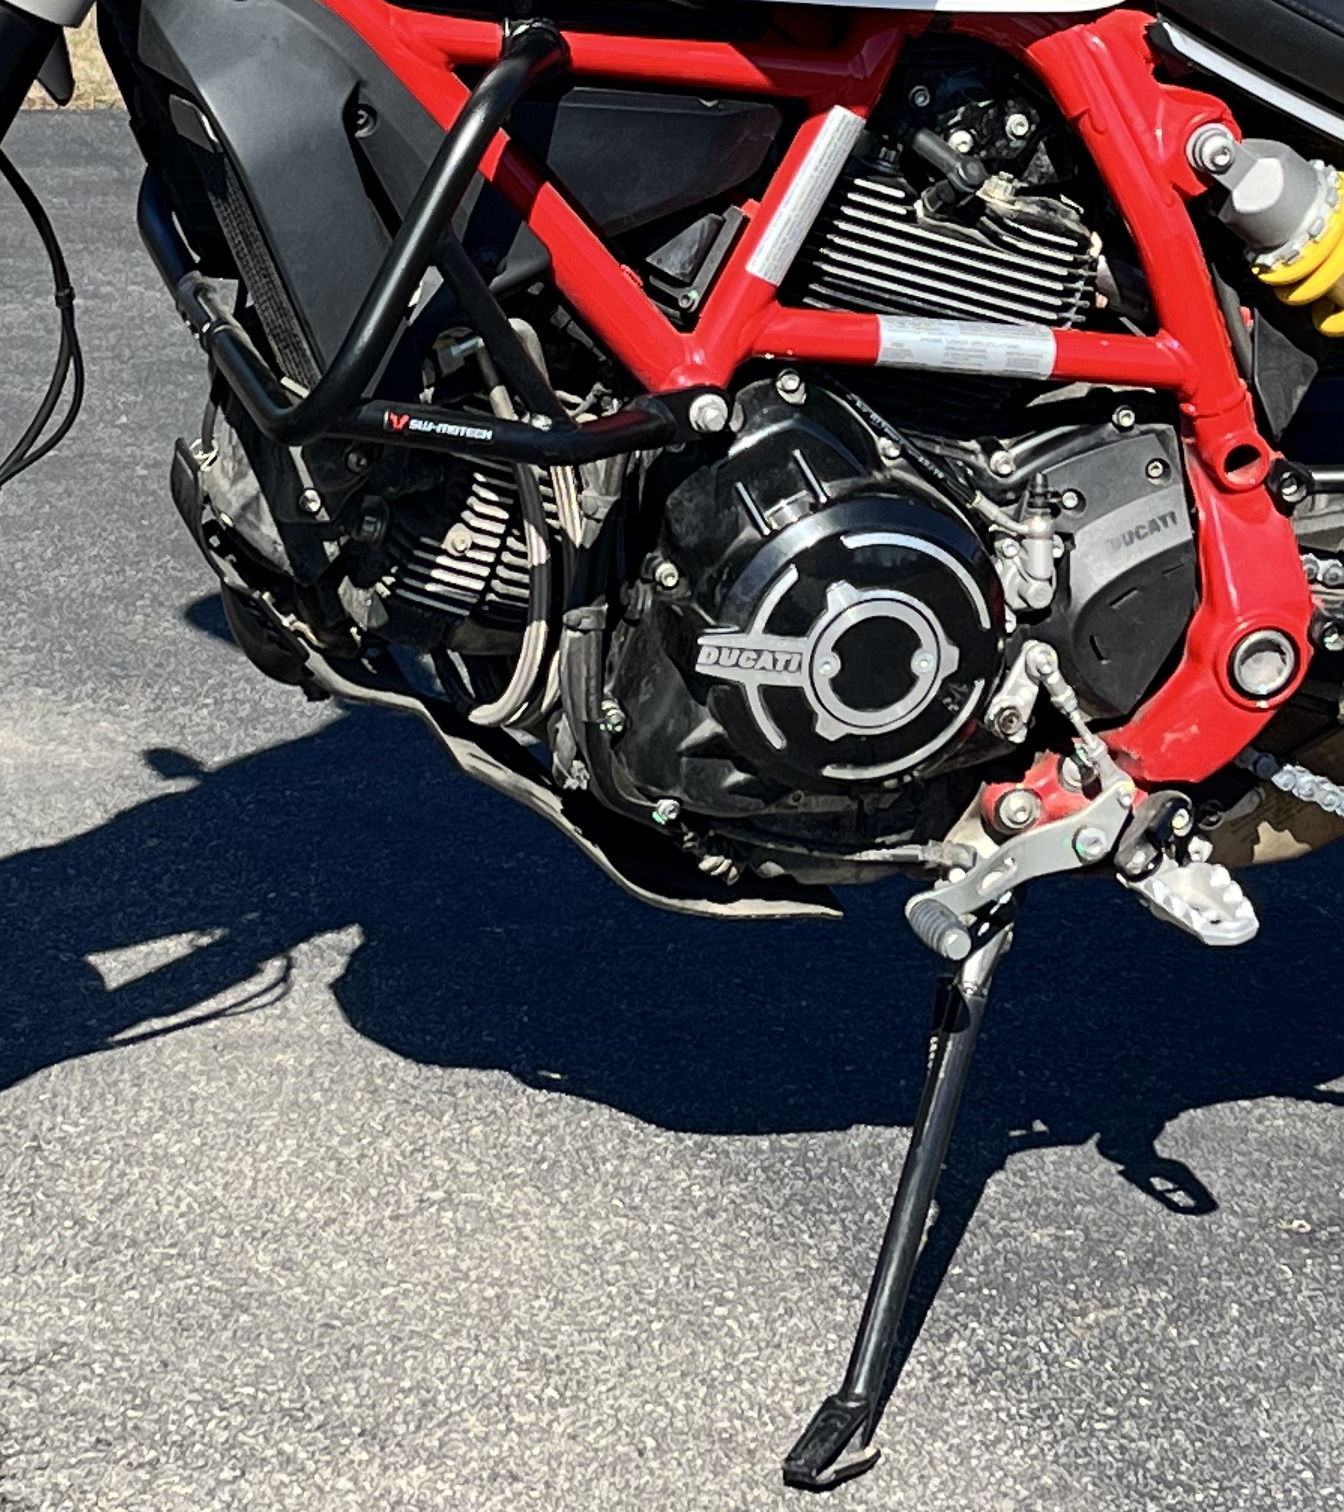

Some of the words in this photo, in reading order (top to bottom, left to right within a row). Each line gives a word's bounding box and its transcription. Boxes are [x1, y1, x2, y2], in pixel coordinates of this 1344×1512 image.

[408, 418, 493, 441] SW-MOTECH
[1104, 510, 1178, 555] DUCATI
[697, 645, 802, 673] DUCATI
